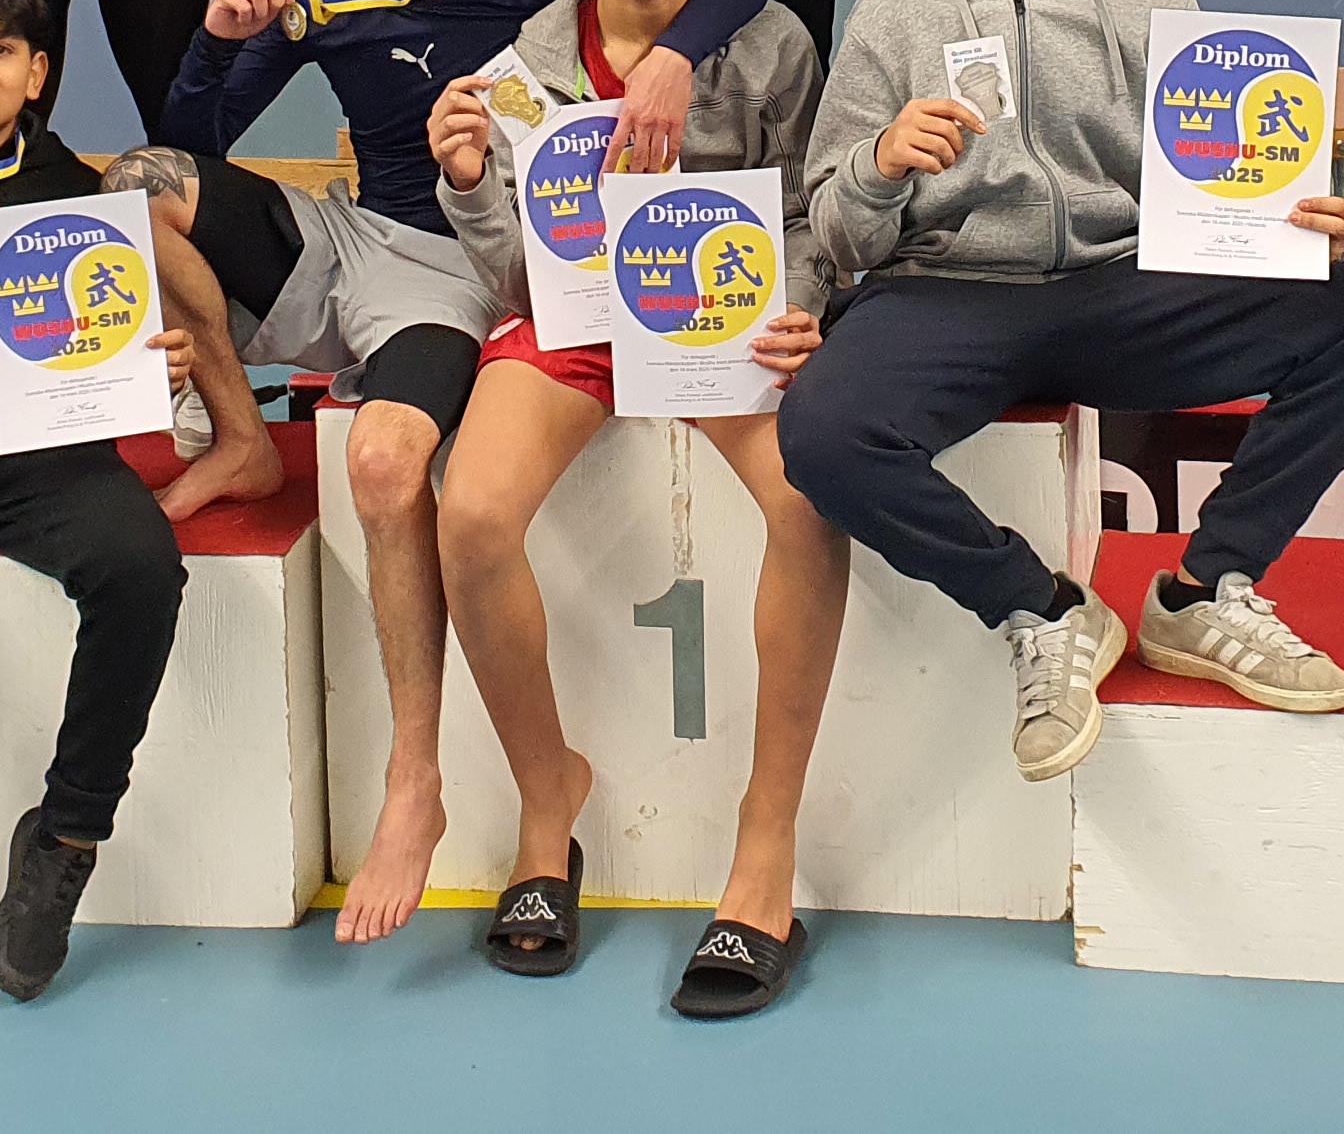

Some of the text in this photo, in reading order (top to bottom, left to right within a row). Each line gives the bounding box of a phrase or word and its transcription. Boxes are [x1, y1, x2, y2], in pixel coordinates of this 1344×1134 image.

[1193, 43, 1290, 70] Diplom
[1256, 89, 1309, 142] 武
[552, 130, 614, 156] Diplo
[1175, 140, 1299, 163] WUSHU-SM
[646, 203, 739, 227] Diplom
[14, 227, 107, 255] Diplom
[713, 241, 764, 287] 武
[86, 262, 137, 308] 武
[634, 579, 706, 740] 1
